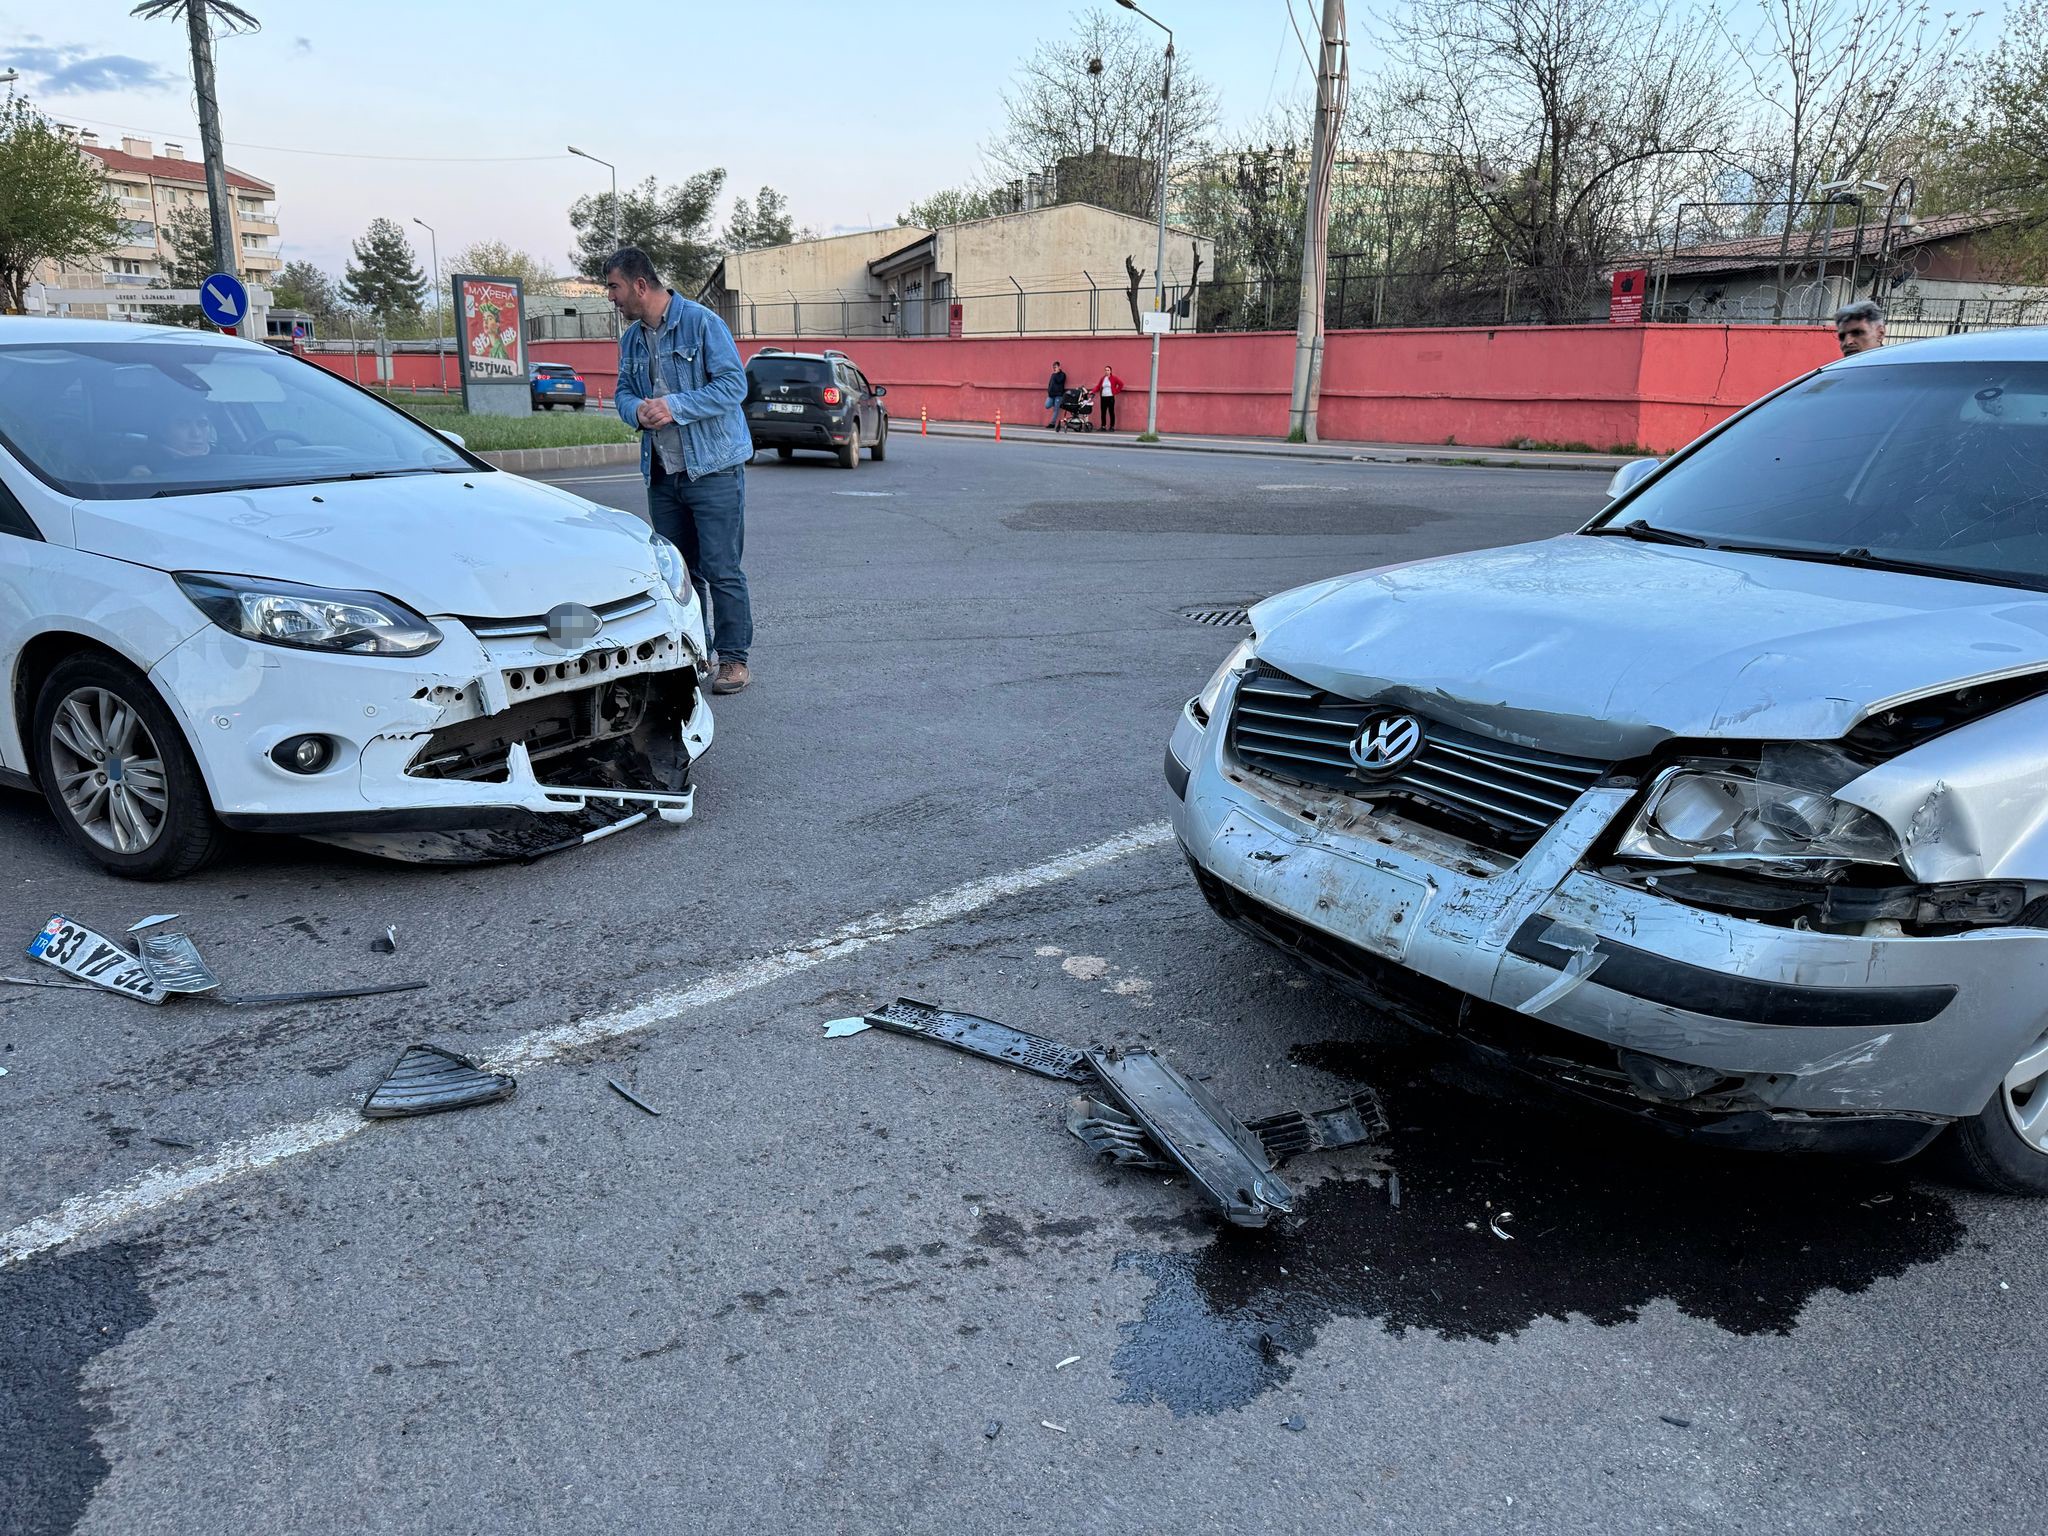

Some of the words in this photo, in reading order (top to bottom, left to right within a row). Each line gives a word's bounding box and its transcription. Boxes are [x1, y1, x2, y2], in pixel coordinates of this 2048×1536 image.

[469, 285, 514, 300] MAXPERA
[38, 937, 48, 949] TR
[45, 925, 88, 965] 33
